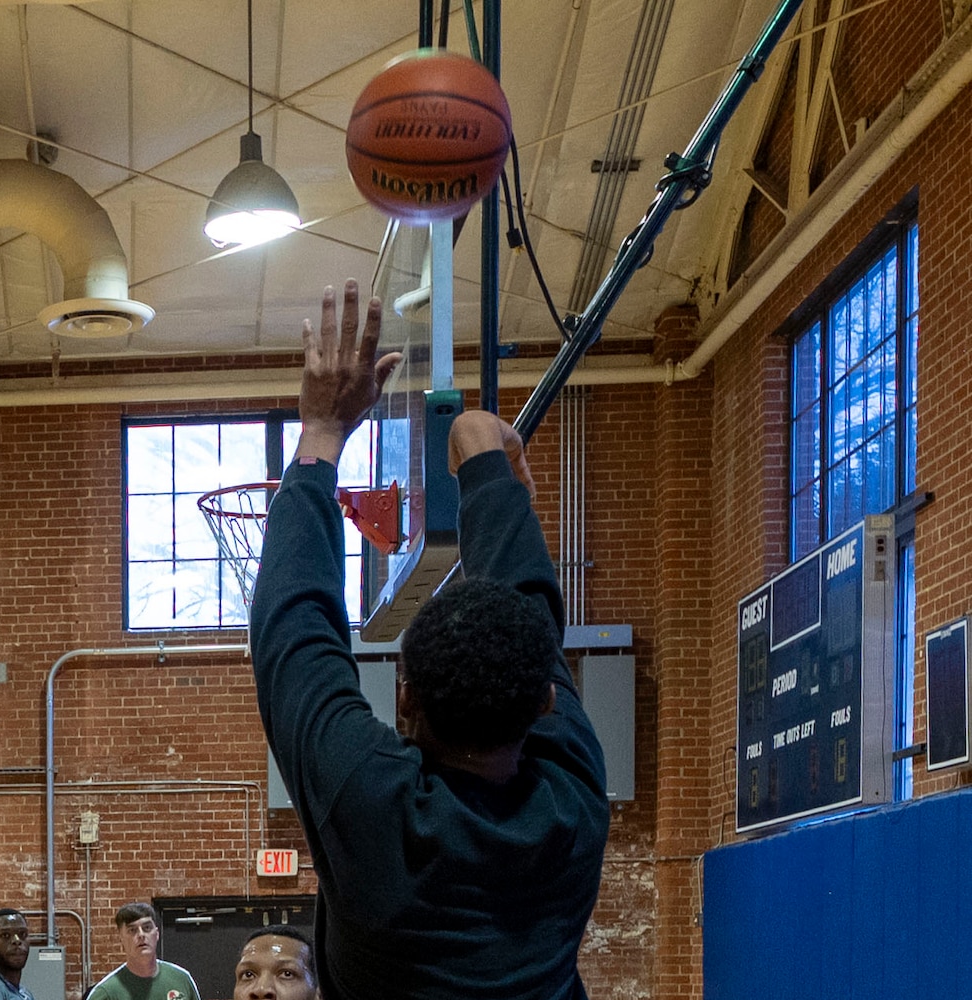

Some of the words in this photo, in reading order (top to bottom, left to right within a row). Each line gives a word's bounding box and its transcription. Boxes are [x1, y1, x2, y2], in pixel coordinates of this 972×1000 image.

[371, 168, 479, 204] Wilson
[827, 537, 857, 580] HOME
[741, 594, 768, 631] GUEST
[771, 668, 797, 698] PERIOD
[830, 705, 851, 728] FOULS
[773, 730, 785, 750] TIME
[786, 724, 800, 744] OUTS
[801, 719, 816, 739] LEFT
[746, 740, 763, 760] FOULS
[264, 851, 293, 873] EXIT
